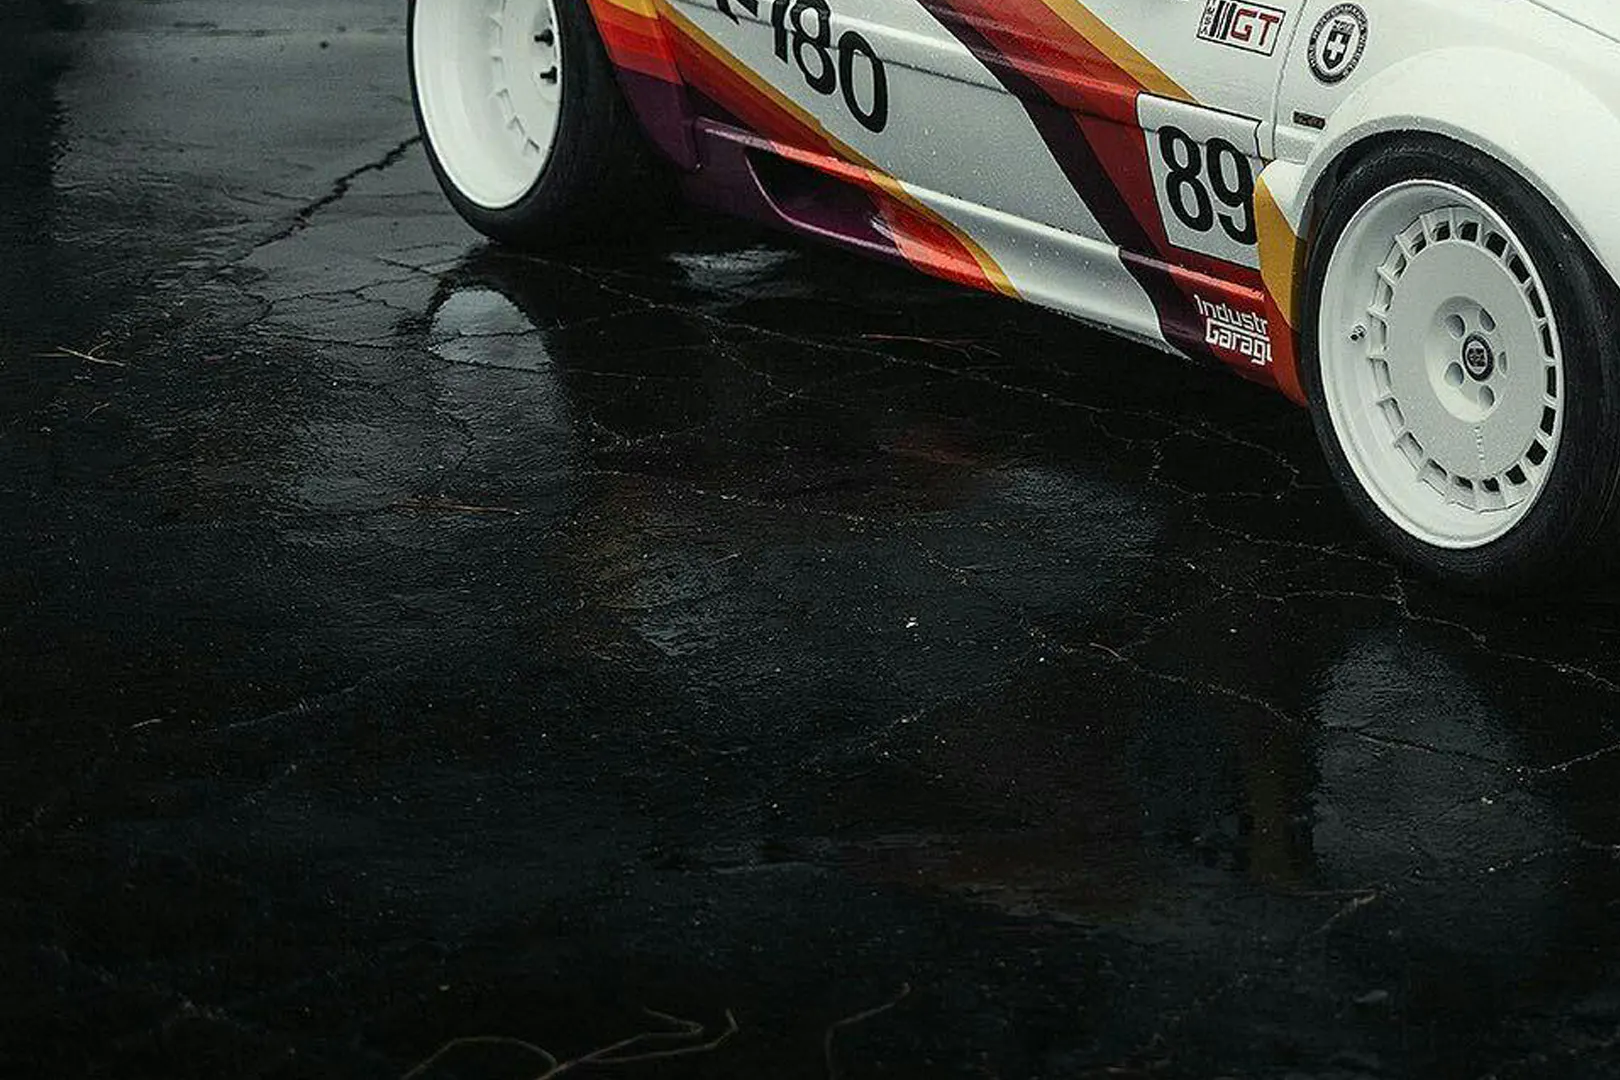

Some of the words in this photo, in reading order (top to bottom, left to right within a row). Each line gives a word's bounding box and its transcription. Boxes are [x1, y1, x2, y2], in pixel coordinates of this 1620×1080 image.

[1231, 8, 1280, 47] GT
[1158, 125, 1257, 245] 89
[1193, 293, 1269, 336] Industr
